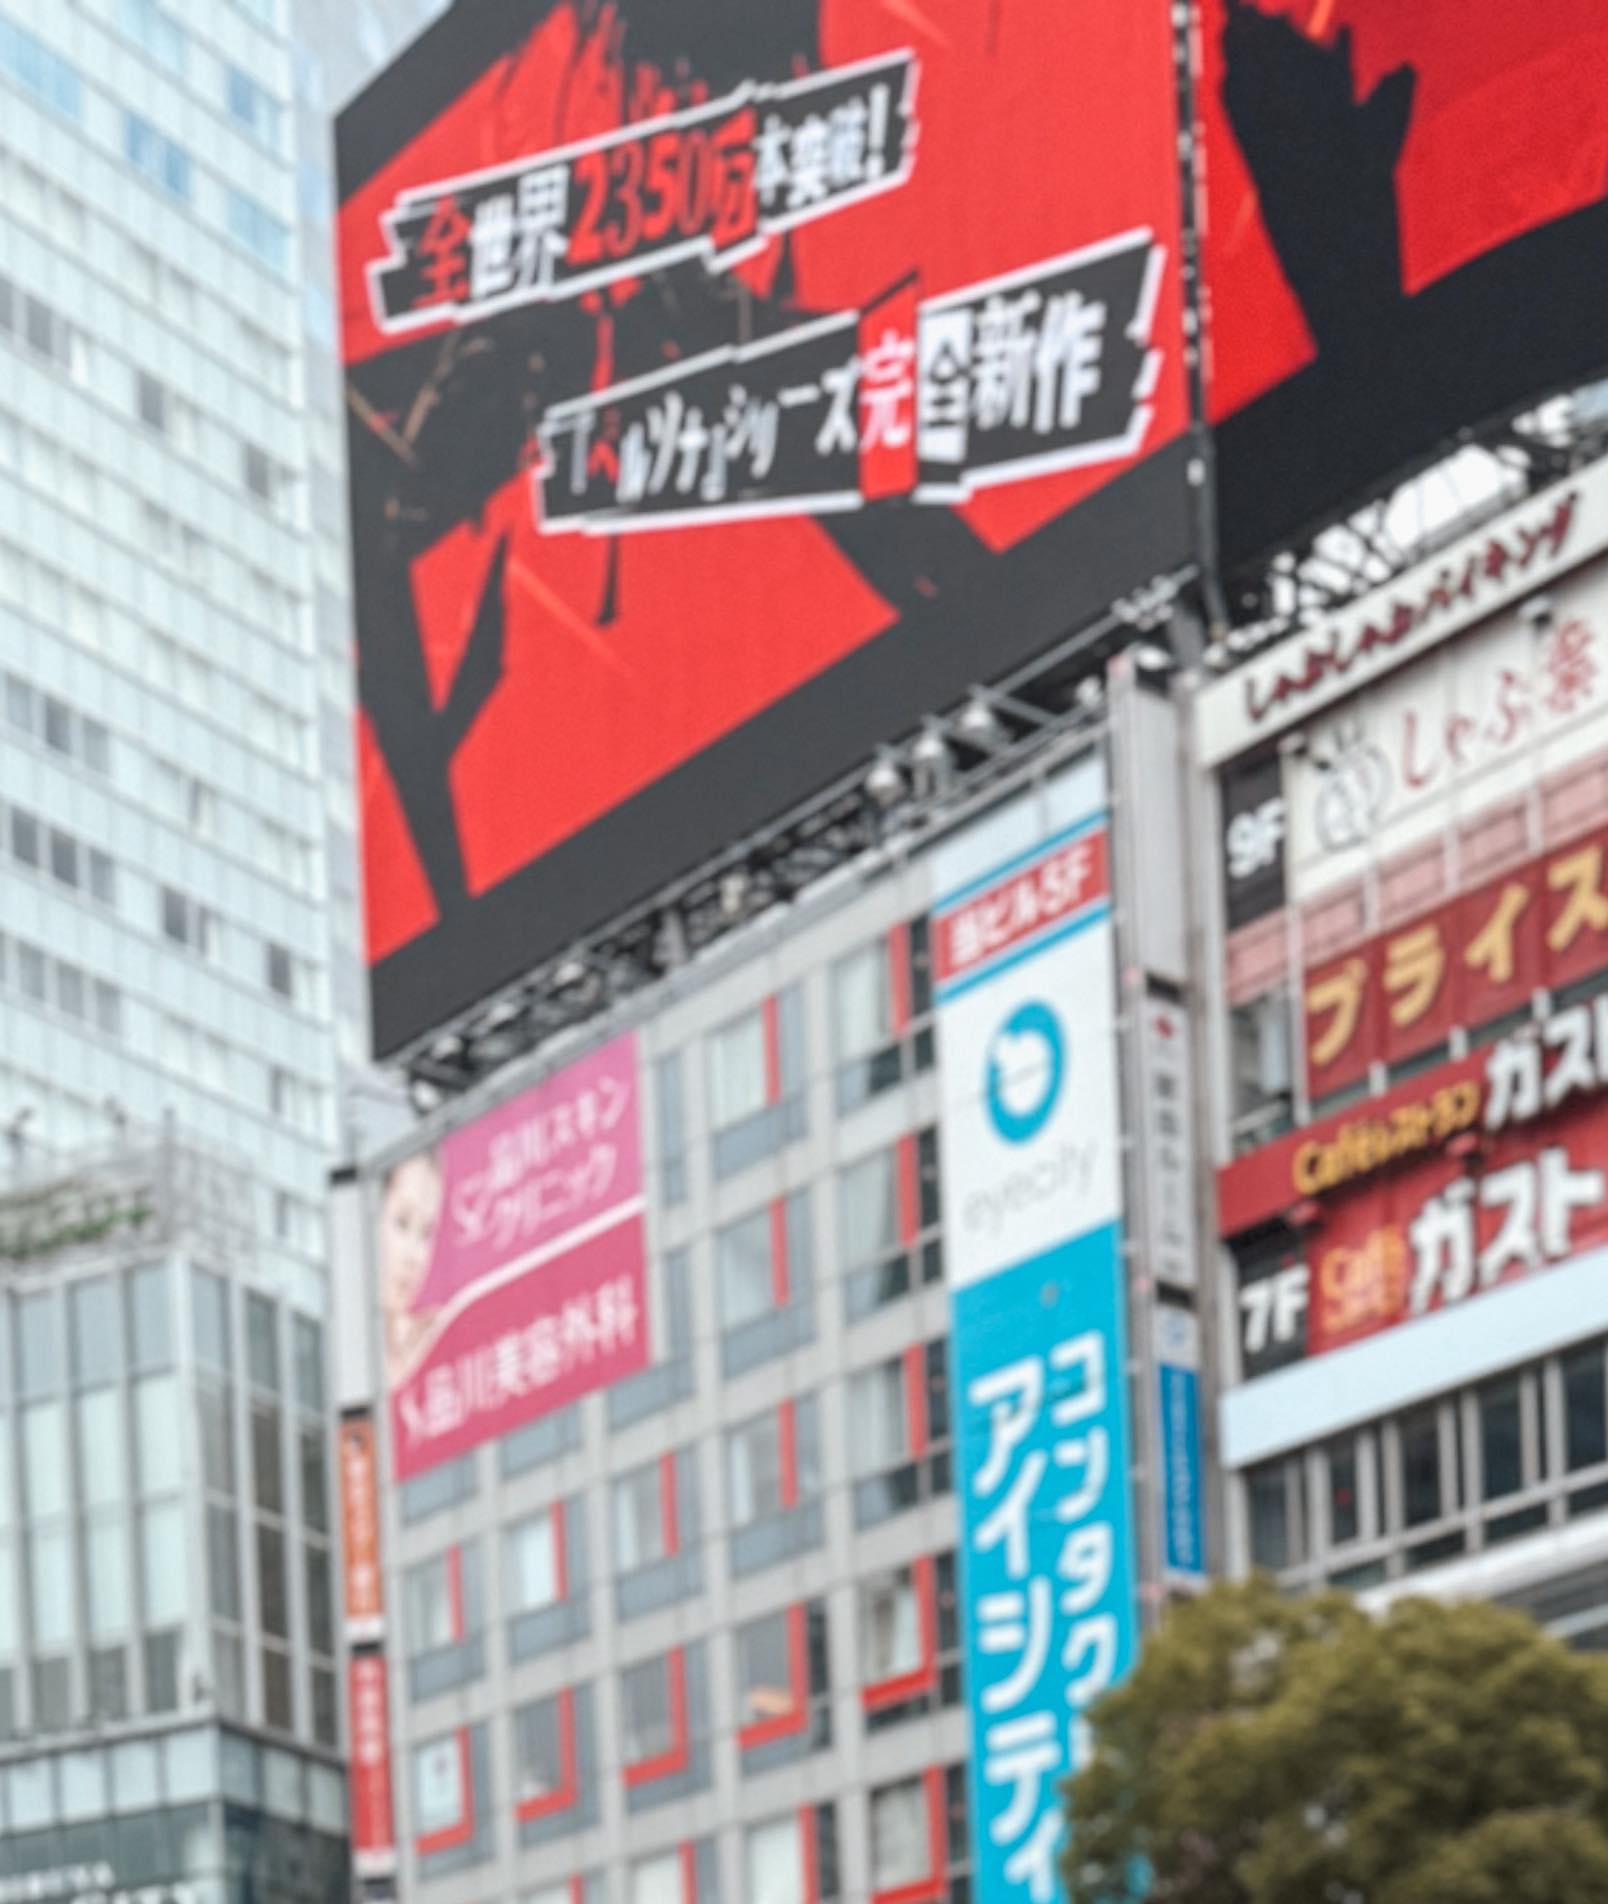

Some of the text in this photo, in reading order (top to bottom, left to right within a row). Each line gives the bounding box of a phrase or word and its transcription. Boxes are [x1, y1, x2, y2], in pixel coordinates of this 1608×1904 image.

[1410, 1147, 1604, 1316] ガスト
[1239, 1265, 1310, 1353] 7F
